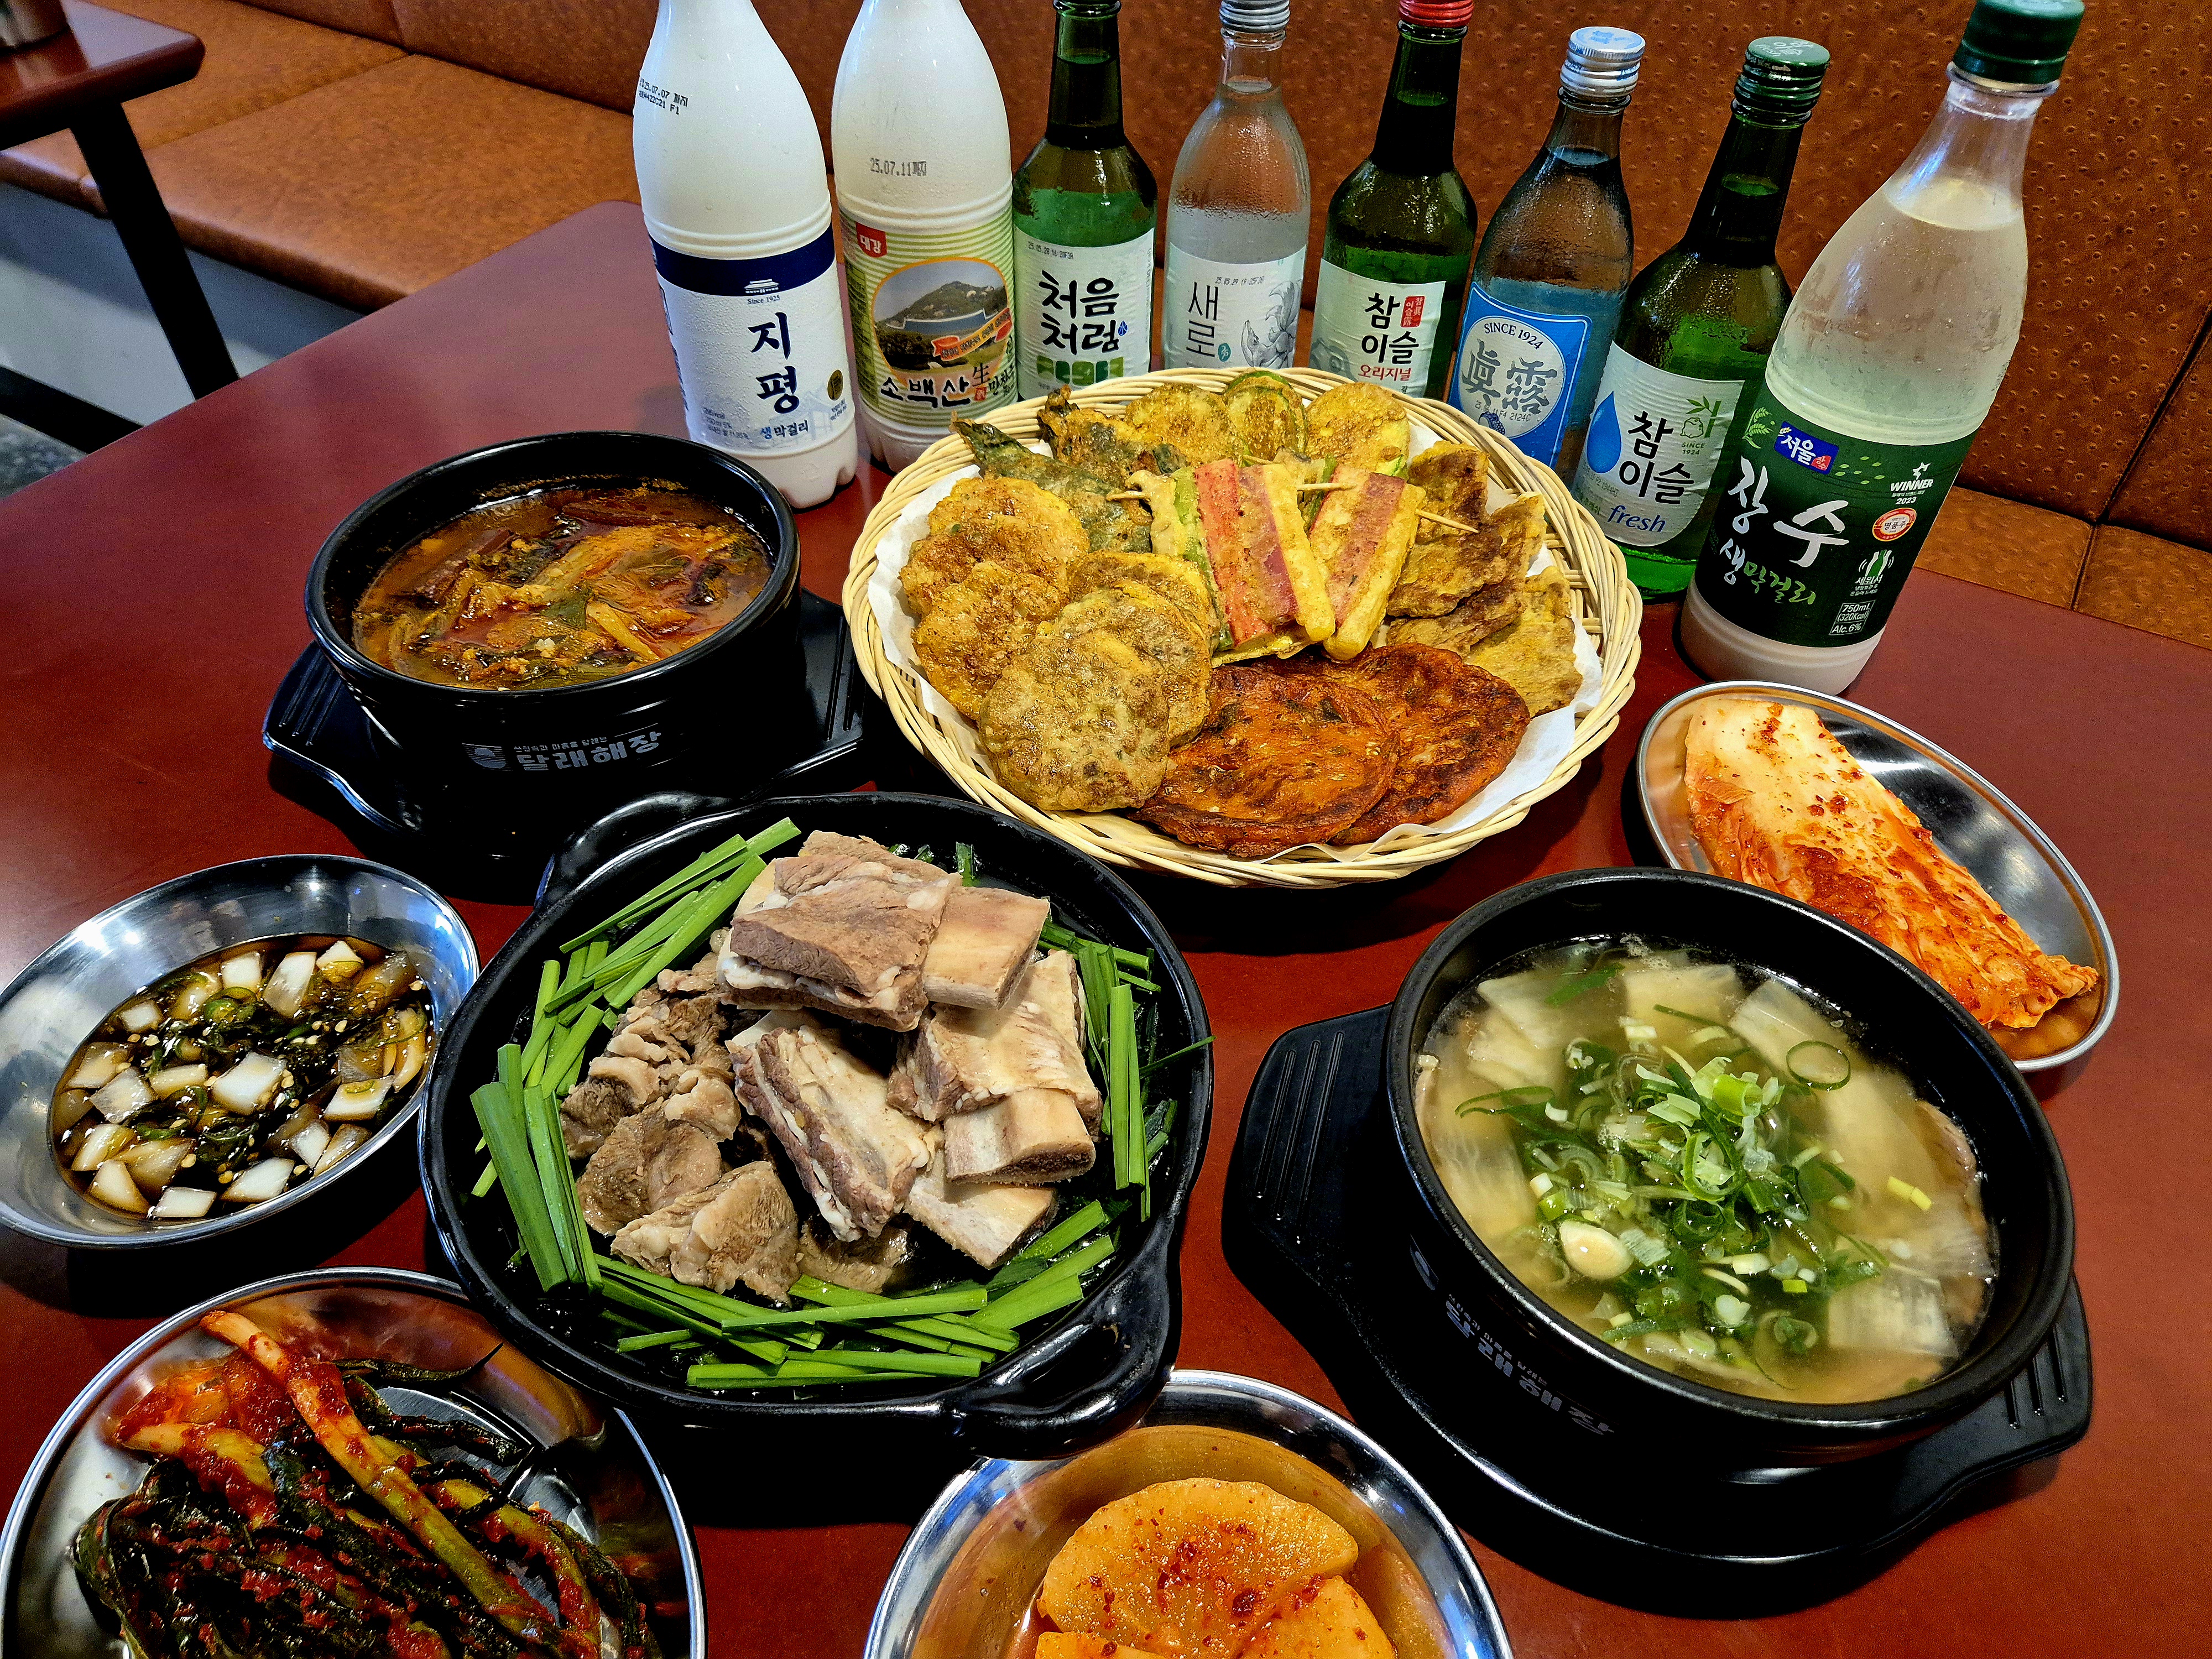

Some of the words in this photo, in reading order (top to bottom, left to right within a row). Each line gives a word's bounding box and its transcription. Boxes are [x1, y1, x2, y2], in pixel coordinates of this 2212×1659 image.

[859, 234, 882, 254] 대강
[765, 294, 781, 303] 1925
[1039, 270, 1120, 319] 처음
[1364, 293, 1401, 330] 참
[1040, 312, 1120, 356] 처럼
[1186, 282, 1219, 358] 새로
[1484, 322, 1517, 336] SINCE
[1517, 329, 1544, 350] 1924
[747, 311, 800, 414] 지평
[1361, 331, 1420, 365] 이슬
[1358, 364, 1412, 382] 오리지널
[880, 376, 972, 409] 소백산
[1627, 410, 1674, 460] 참
[1781, 434, 1816, 465] 서울
[1619, 460, 1694, 504] 이슬
[1890, 479, 1934, 492] WINNER
[1728, 455, 1850, 568] 장수
[1895, 496, 1917, 505] 2023
[1608, 505, 1666, 533] fresh
[1841, 602, 1871, 613] 750mL
[517, 731, 661, 771] 달래해장
[1446, 1300, 1615, 1435] 달래해장
